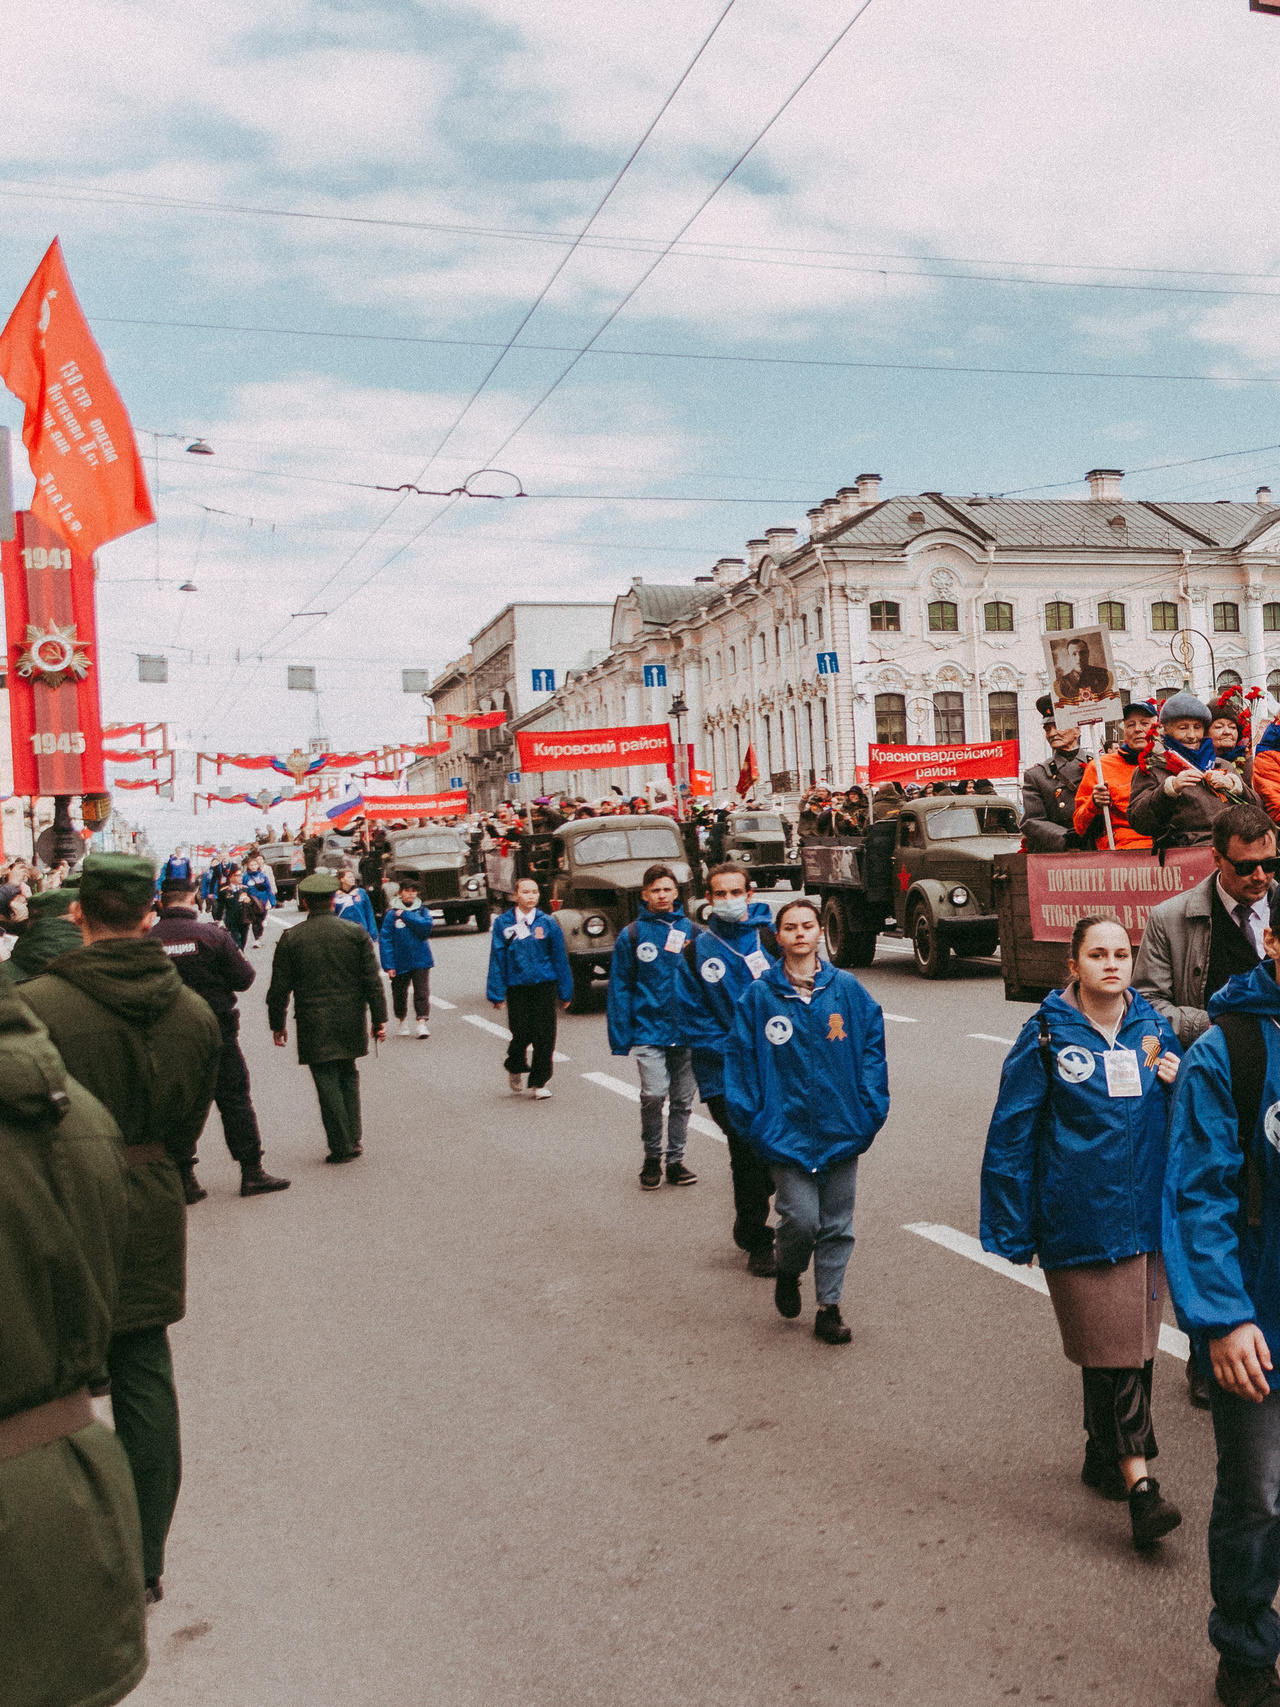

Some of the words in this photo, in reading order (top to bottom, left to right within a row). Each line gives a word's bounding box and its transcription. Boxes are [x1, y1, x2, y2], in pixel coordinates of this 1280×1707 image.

[58, 360, 84, 387] 150
[20, 547, 72, 570] 1941
[30, 732, 86, 754] 1945
[533, 739, 616, 759] Кировский
[620, 736, 668, 755] район
[871, 745, 1004, 764] Красногвардейский
[915, 763, 957, 780] район
[438, 798, 467, 809] район
[1047, 867, 1106, 893] ПОМНИТЕ
[1110, 865, 1184, 892] ПРОШЛОЕ
[1041, 904, 1081, 928] ЧТОБЫ
[1123, 904, 1134, 930] В
[162, 942, 196, 955] ИЦИЯ
